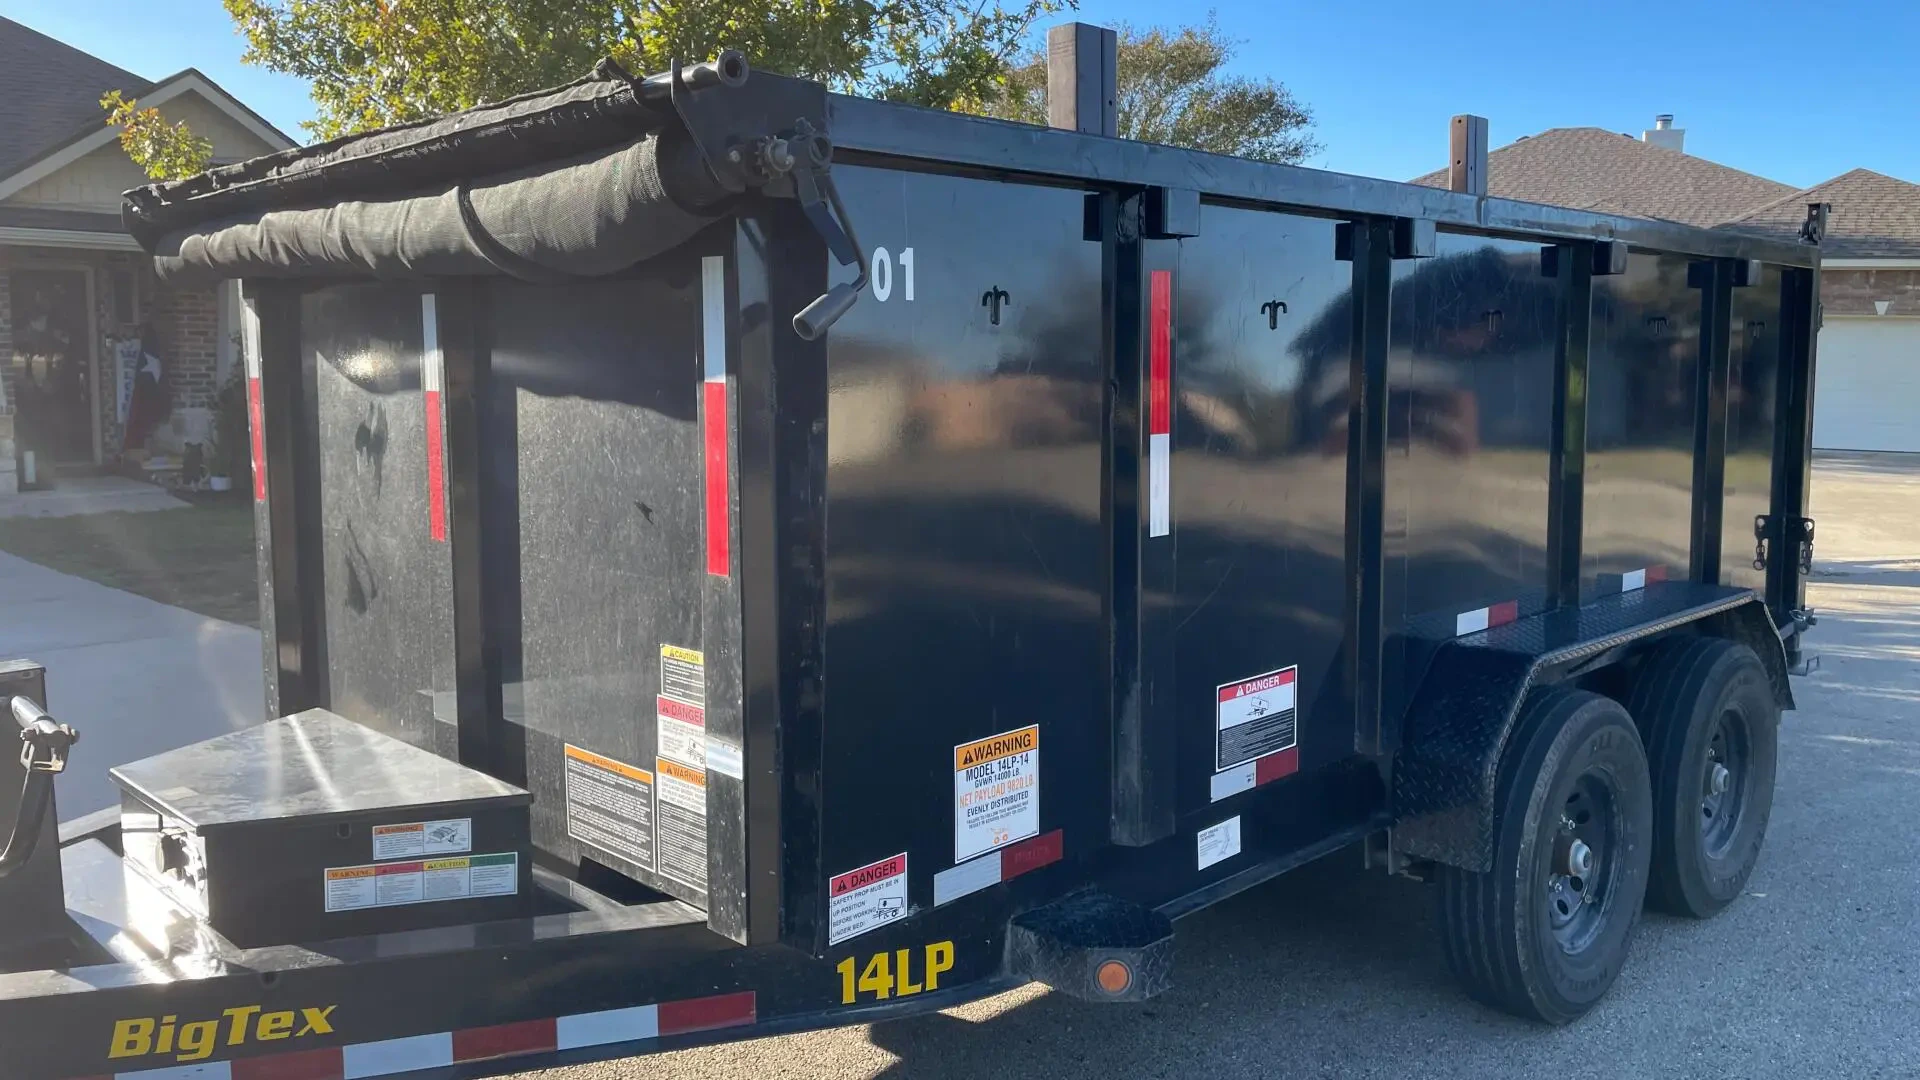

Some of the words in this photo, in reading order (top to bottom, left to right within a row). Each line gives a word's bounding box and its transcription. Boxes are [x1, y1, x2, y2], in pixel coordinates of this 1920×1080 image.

[872, 247, 914, 301] 01
[675, 649, 699, 662] CAUTION
[1246, 675, 1280, 694] DANGER
[974, 733, 1031, 761] WARNING
[673, 766, 705, 786] WARNING
[966, 763, 995, 782] MODEL
[998, 752, 1029, 772] 14LP-14
[975, 775, 993, 788] GVWR
[993, 769, 1011, 782] 14000
[960, 792, 973, 808] NET
[975, 782, 1006, 804] PAYLOAD
[967, 803, 989, 817] EVENLY
[990, 790, 1029, 811] DISTRIBUTED
[851, 861, 897, 887] DANGER
[833, 894, 853, 906] SAFETY
[854, 889, 869, 898] PROP
[870, 883, 884, 894] MUST
[833, 916, 852, 928] BEFORE
[853, 906, 876, 919] WORKING
[841, 900, 866, 913] POSITION
[833, 927, 852, 938] UNDER
[837, 940, 954, 1004] 14LP
